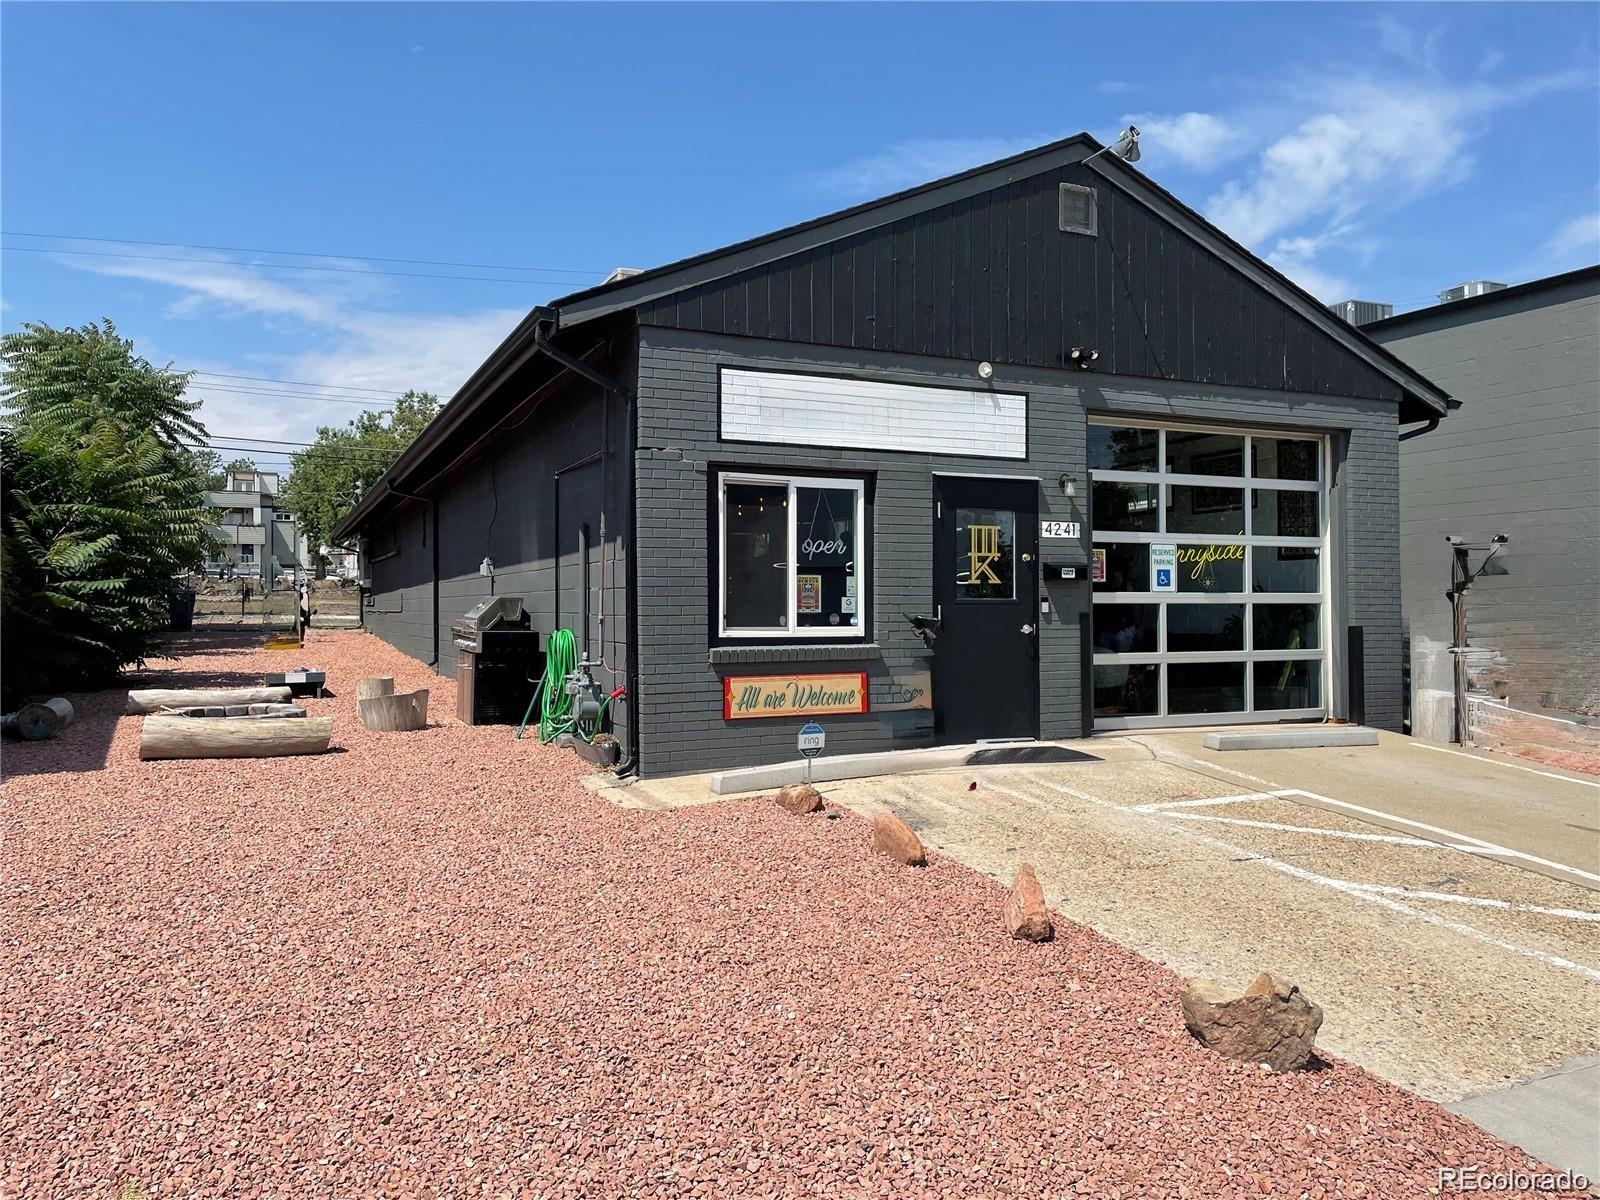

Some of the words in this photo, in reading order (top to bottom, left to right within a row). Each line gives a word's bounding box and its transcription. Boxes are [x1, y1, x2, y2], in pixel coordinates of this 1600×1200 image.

[1045, 523, 1076, 536] 4241
[801, 538, 847, 560] open
[736, 685, 761, 712] All
[764, 690, 786, 710] are
[786, 681, 856, 709] Welcome
[804, 737, 820, 746] ring
